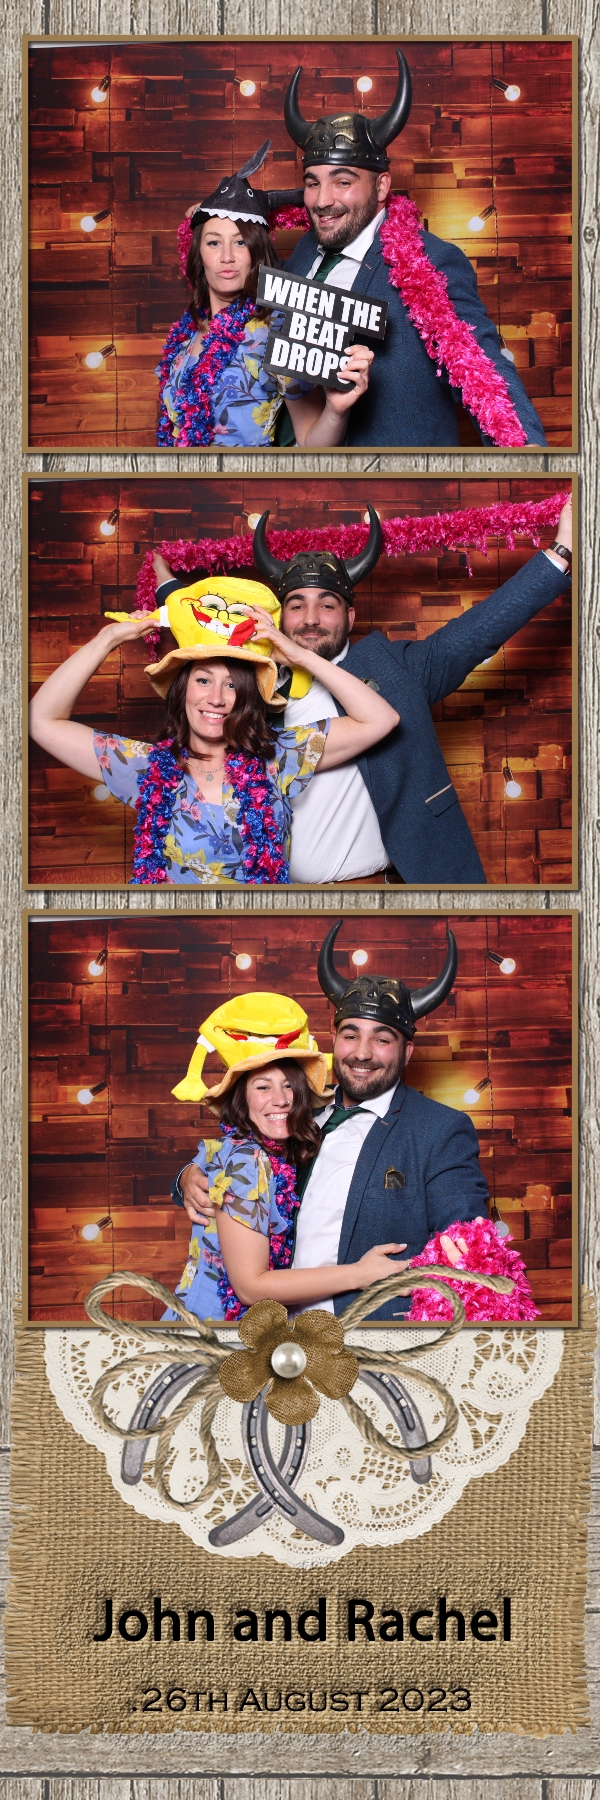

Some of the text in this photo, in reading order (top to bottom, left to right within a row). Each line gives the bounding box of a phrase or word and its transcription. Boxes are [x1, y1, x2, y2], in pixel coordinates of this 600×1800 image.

[263, 273, 382, 332] WHEN THE
[288, 311, 349, 352] BEAT
